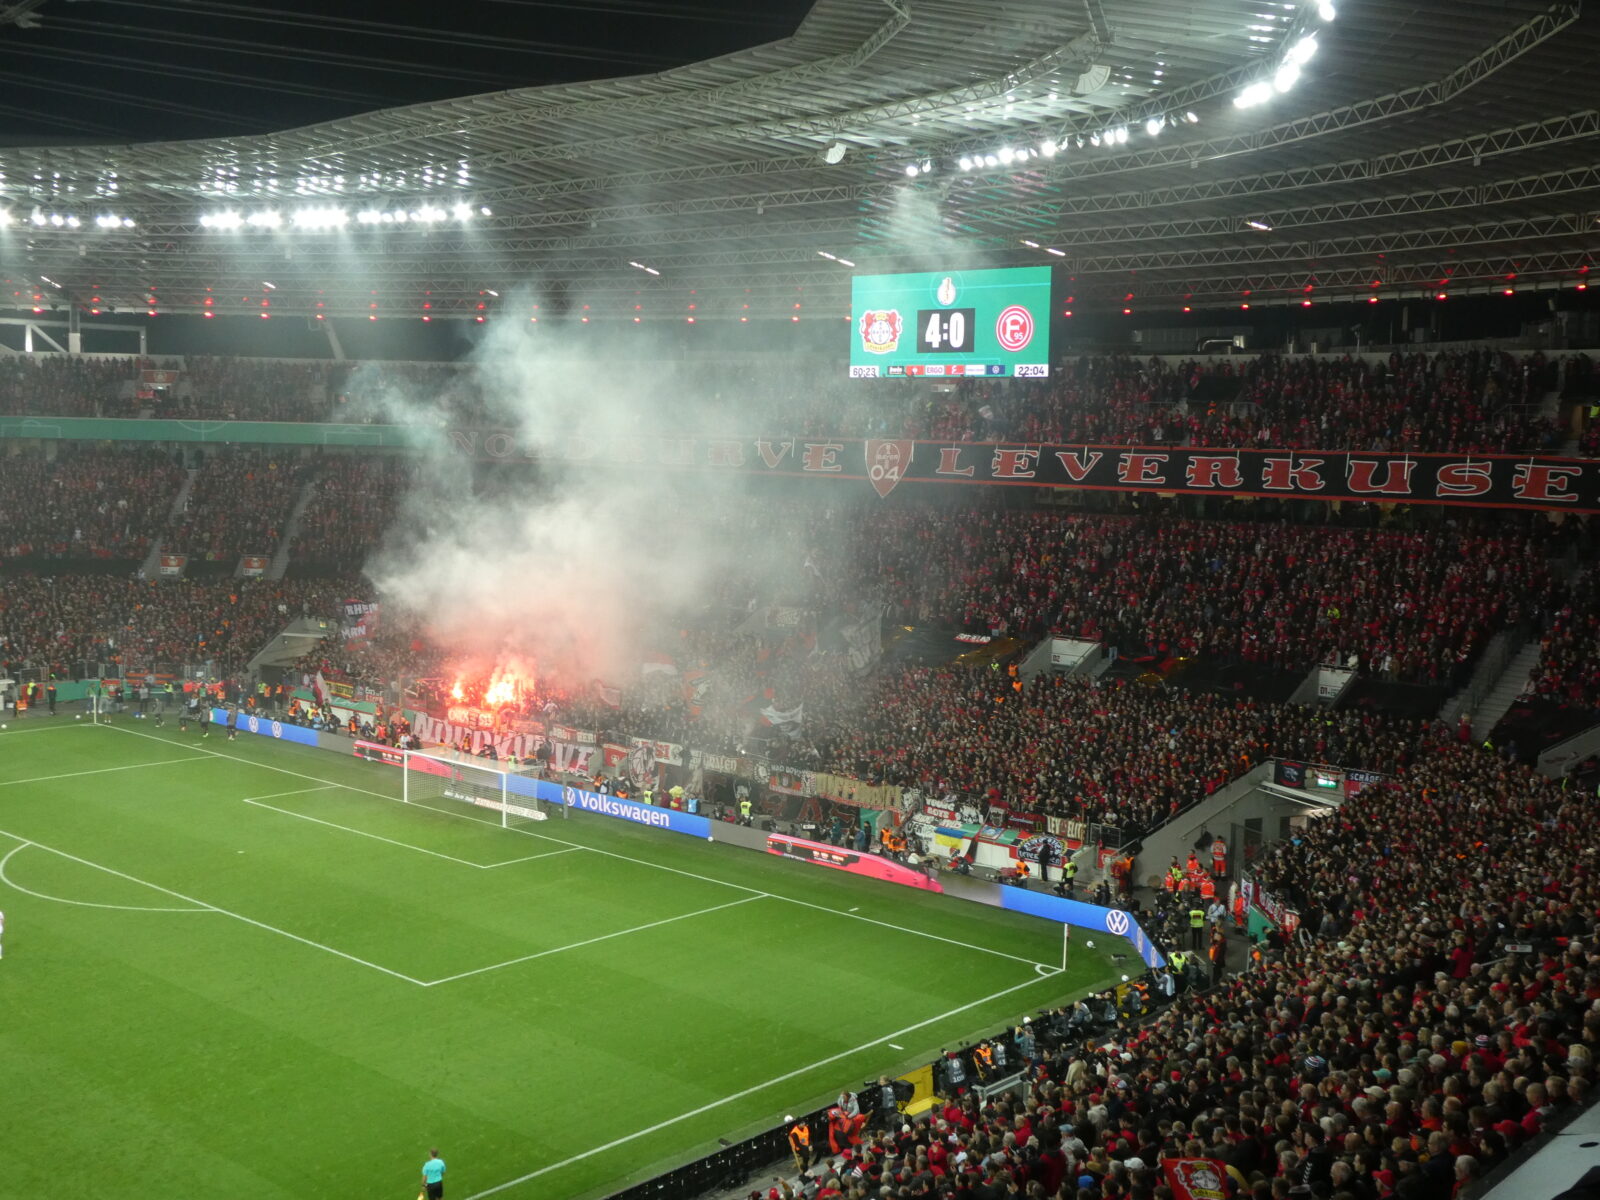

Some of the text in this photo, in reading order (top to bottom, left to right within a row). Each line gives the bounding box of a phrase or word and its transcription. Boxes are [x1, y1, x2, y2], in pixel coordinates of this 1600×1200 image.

[924, 312, 965, 349] 4:0
[852, 367, 876, 377] 60:23
[926, 366, 943, 374] ERGO
[1018, 366, 1045, 376] 22:04
[870, 464, 899, 481] 04
[935, 447, 1600, 503] LEVERKUSE
[579, 789, 669, 827] Volkswagen
